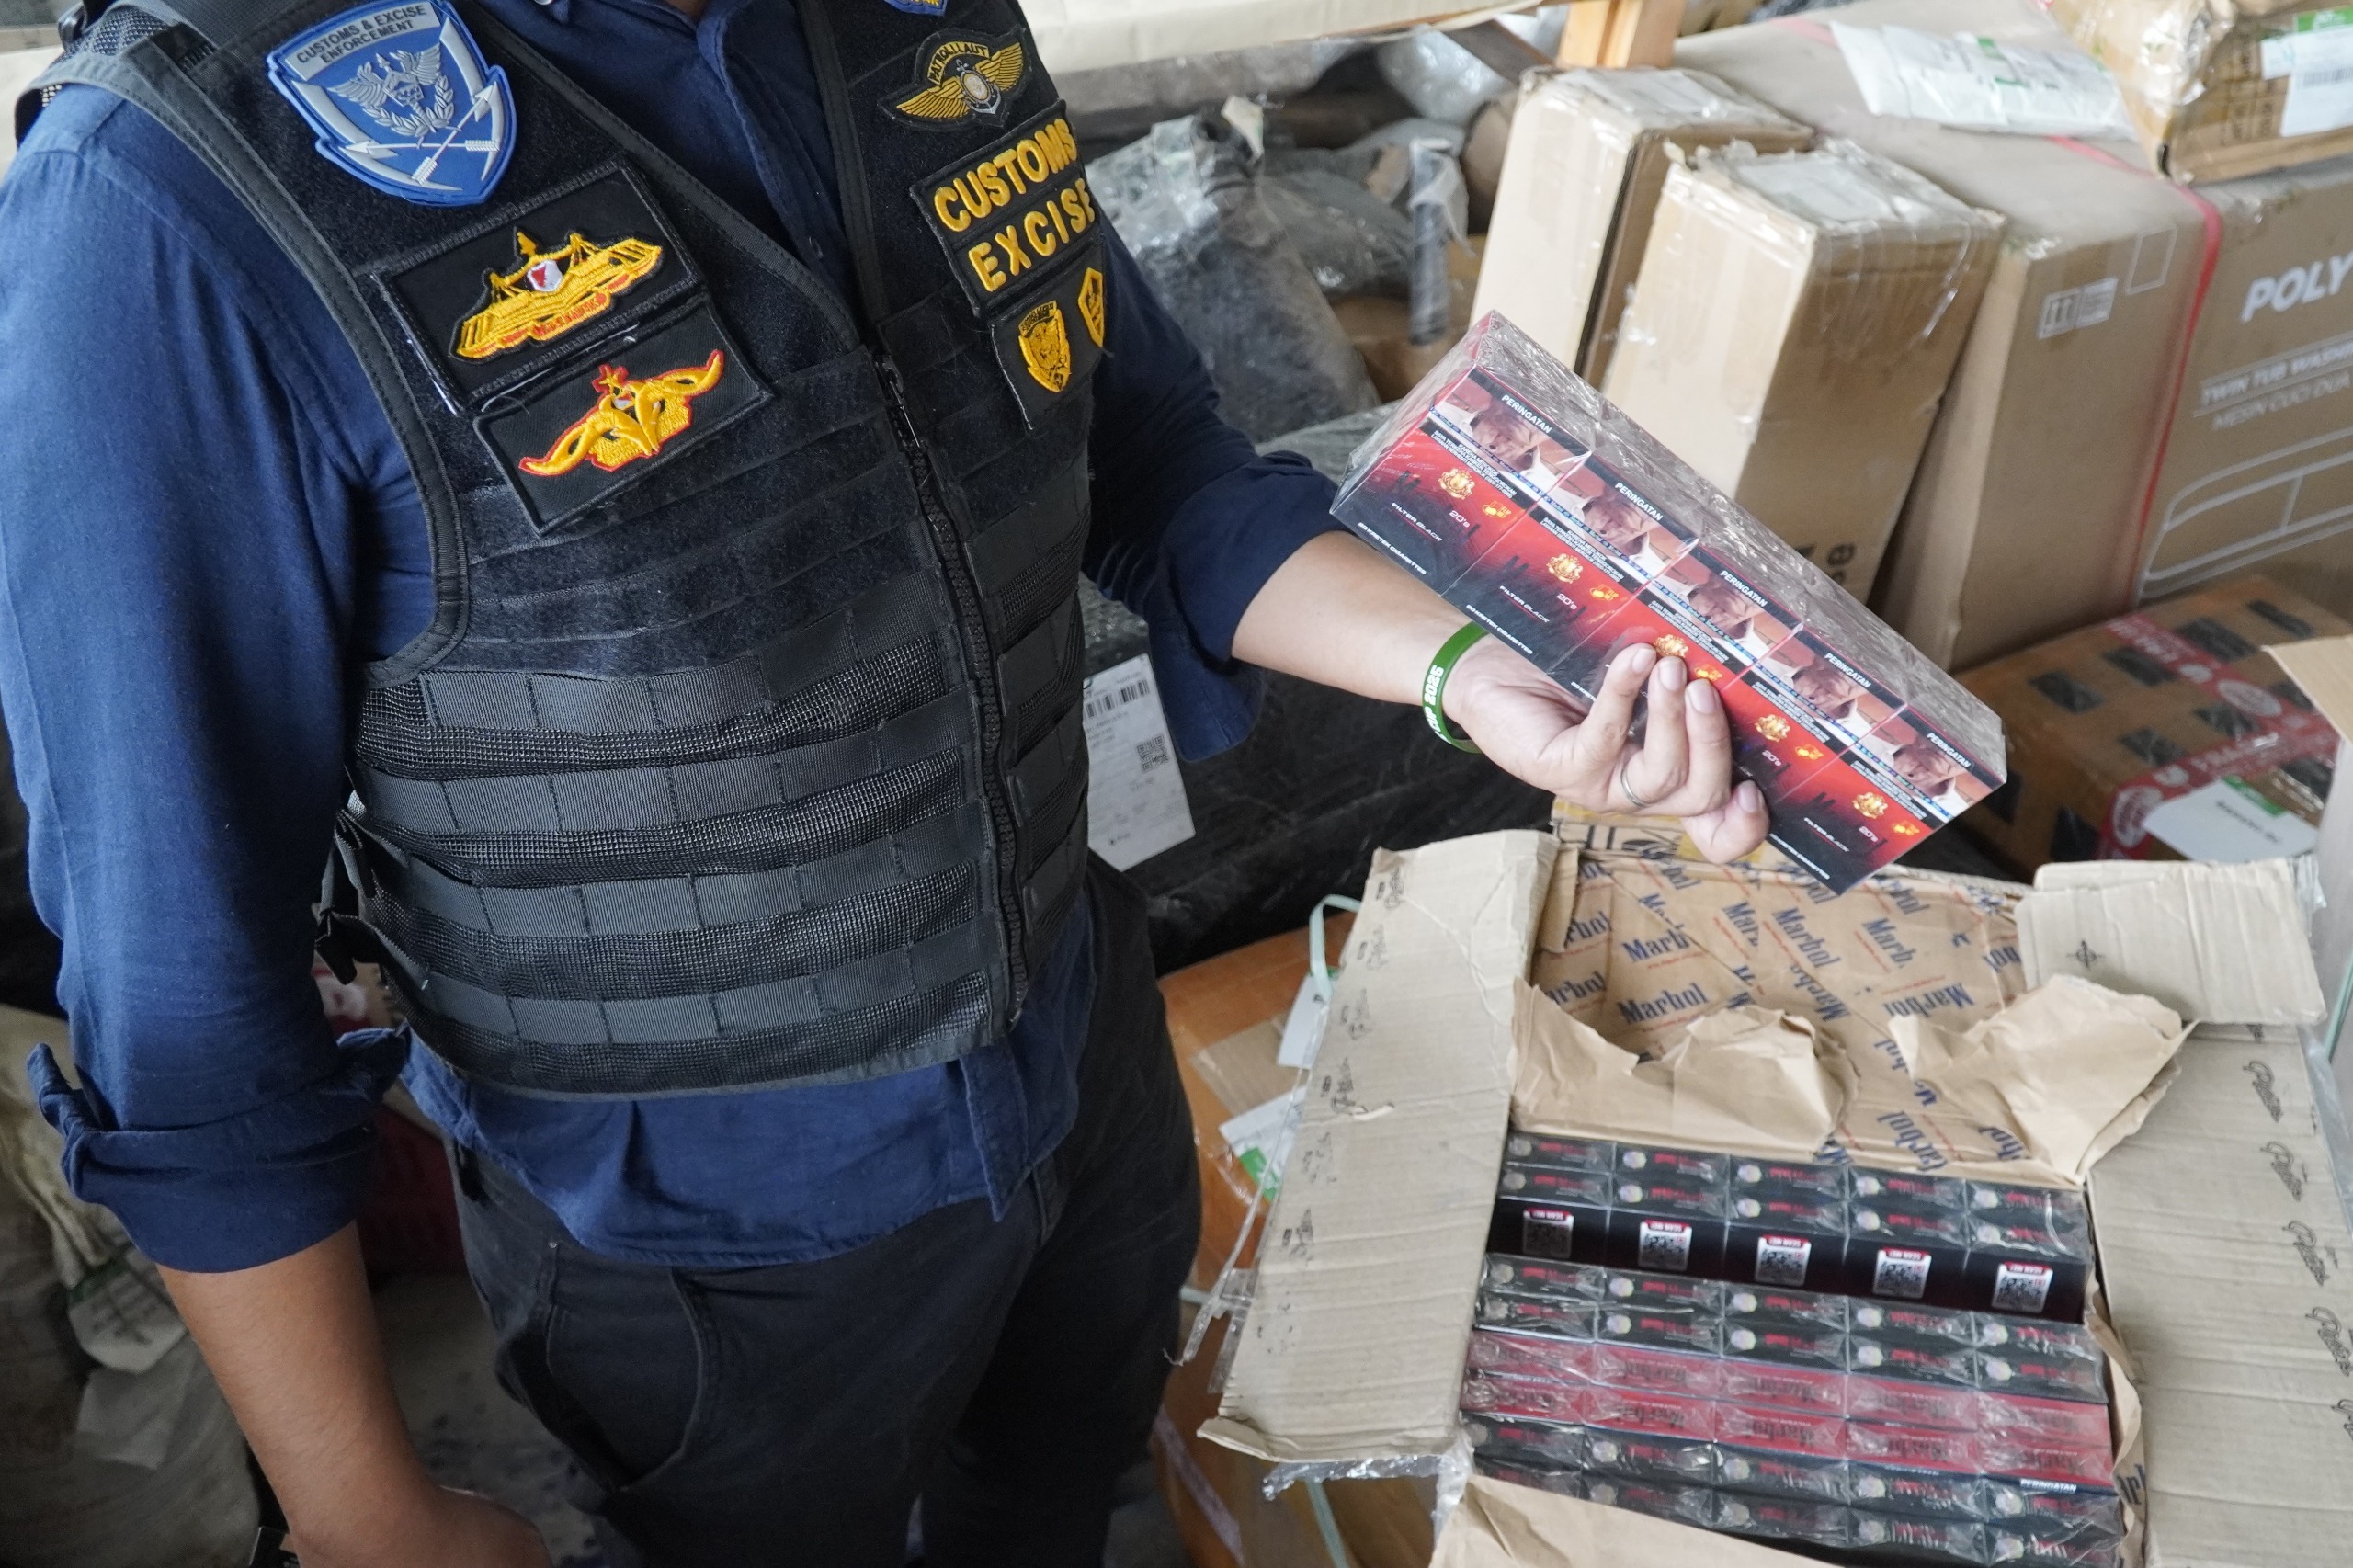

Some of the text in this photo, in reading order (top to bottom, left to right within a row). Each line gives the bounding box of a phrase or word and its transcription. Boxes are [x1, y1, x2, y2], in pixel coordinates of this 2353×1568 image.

[296, 5, 427, 64] CUSTOMS & EXCISE
[320, 19, 415, 64] ENFORCEMENT
[934, 118, 1077, 232] CUSTOMS
[968, 177, 1095, 292] EXCISE
[1500, 392, 1552, 435] PERINGATAN
[1432, 429, 1447, 441] SAYA
[1448, 508, 1472, 528] 20's
[1613, 481, 1664, 522] PERINGATAN
[1390, 501, 1443, 543] FILTER BLACK
[1364, 527, 1392, 549] KRETEK
[1388, 545, 1427, 575] CIGARETTES
[1498, 584, 1550, 624] FILTER BLACK
[1555, 591, 1579, 610] 20's
[1719, 568, 1768, 608] PERINGATAN
[1472, 608, 1499, 629] KRETEK
[1424, 665, 1445, 706] 2025
[1824, 653, 1871, 688] PERINGATAN
[1761, 750, 1782, 767] 20's
[1927, 732, 1972, 768] PERINGATAN
[1772, 906, 1841, 969] Marbol
[1616, 982, 1710, 1024] Marbol
[1883, 983, 1974, 1018] Marbol
[2020, 1479, 2077, 1494] PERINGATAN
